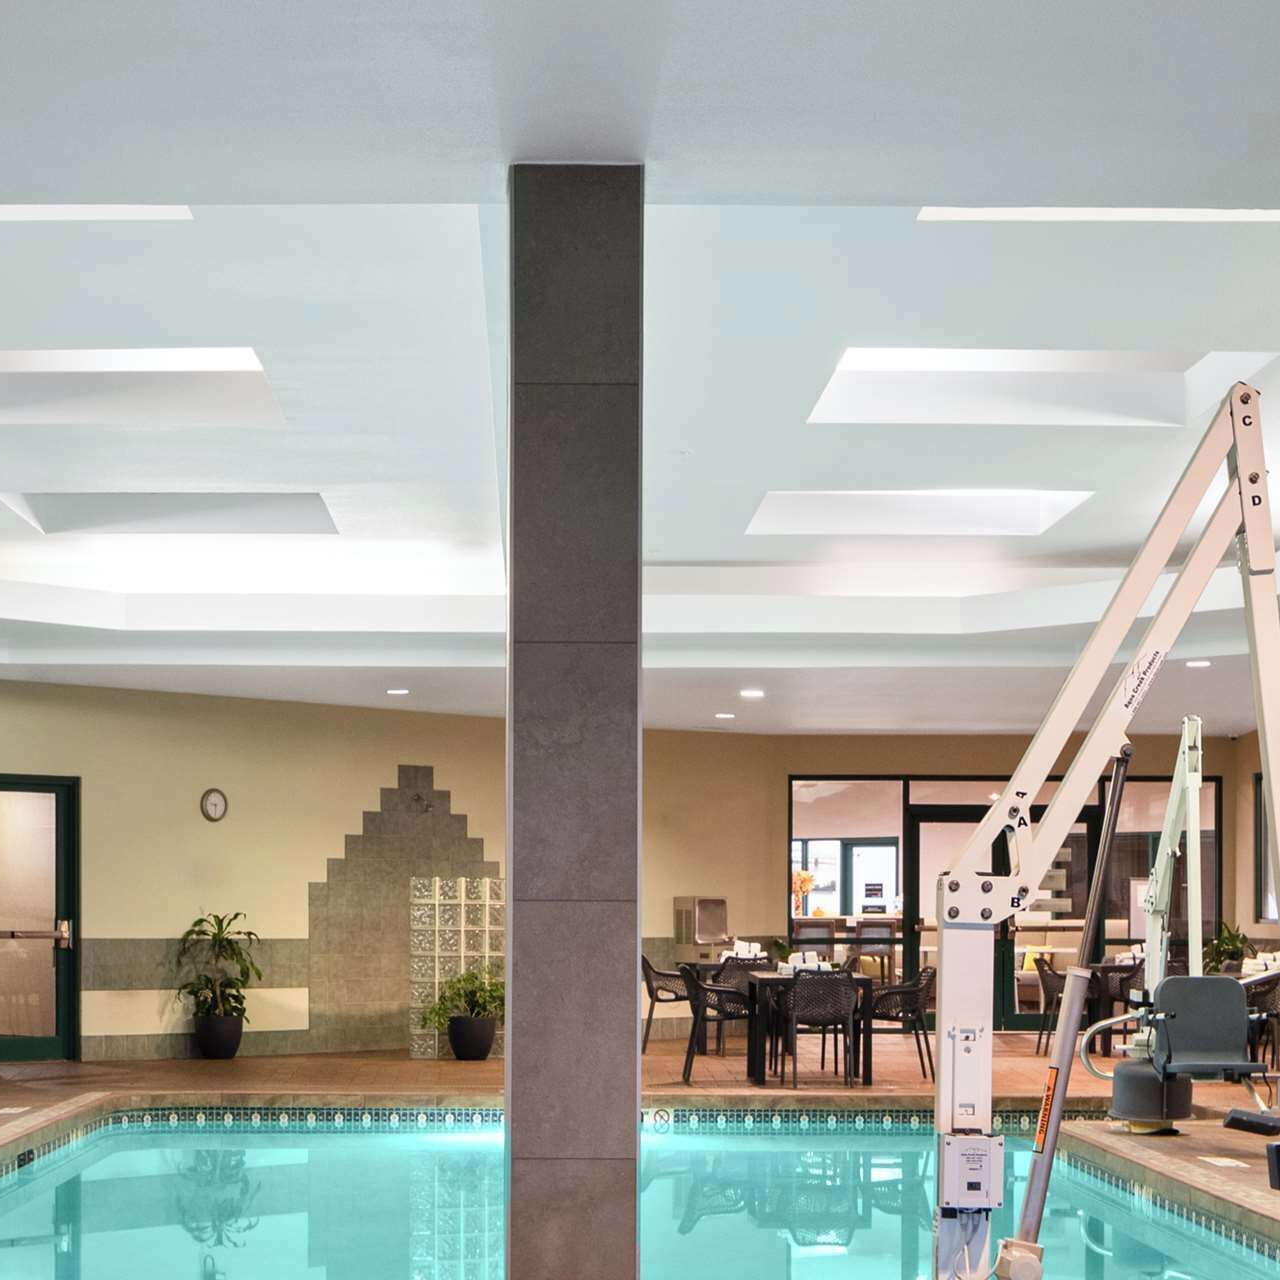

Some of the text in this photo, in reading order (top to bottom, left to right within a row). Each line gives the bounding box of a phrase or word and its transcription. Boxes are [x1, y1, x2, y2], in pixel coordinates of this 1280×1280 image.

[1242, 415, 1253, 426] C
[1252, 495, 1262, 506] D
[1017, 816, 1029, 828] A
[1010, 897, 1021, 908] B
[1038, 1094, 1052, 1135] WARNING
